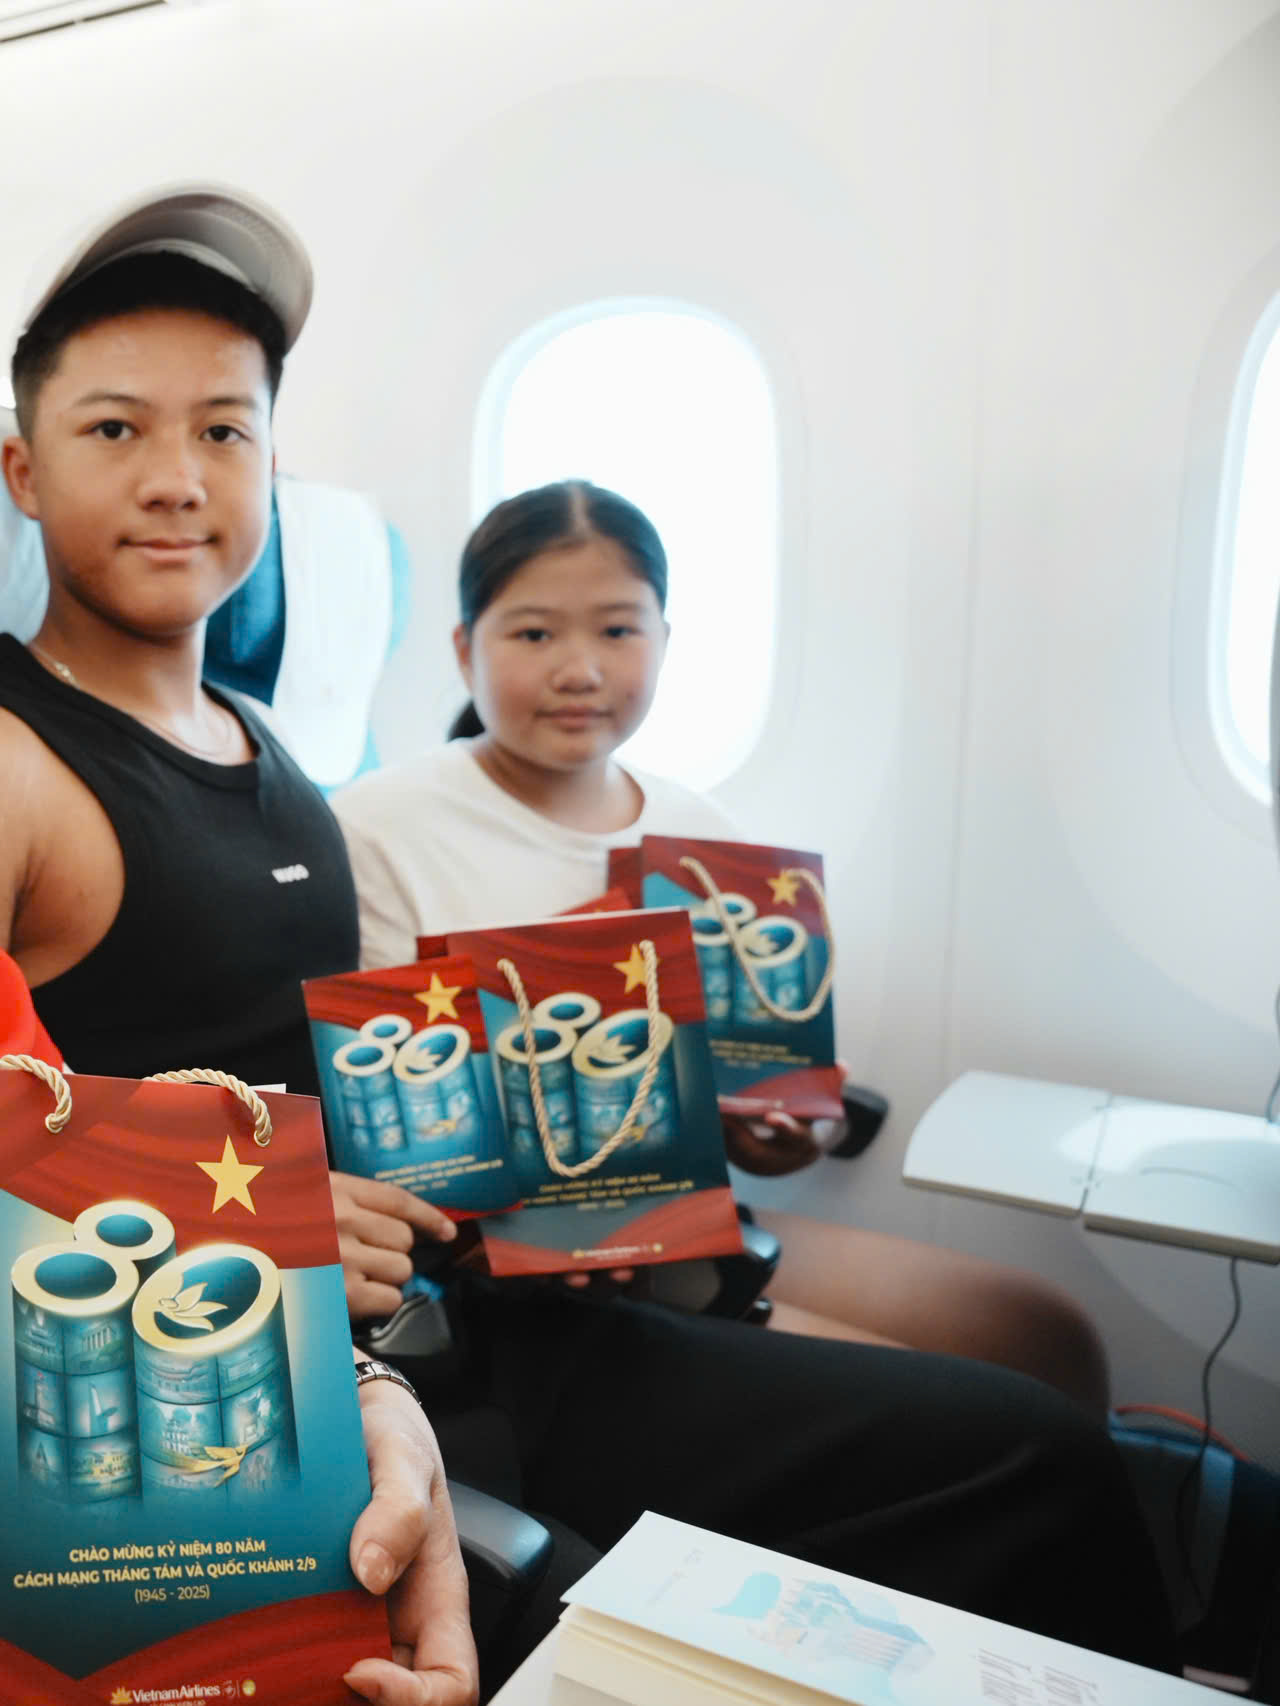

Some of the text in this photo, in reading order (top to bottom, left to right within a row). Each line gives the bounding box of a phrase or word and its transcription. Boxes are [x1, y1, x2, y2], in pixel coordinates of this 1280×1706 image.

[69, 1546, 110, 1563] CHÀO
[112, 1543, 154, 1561] MỪNG
[179, 1539, 212, 1559] NIỆM
[215, 1541, 232, 1556] 80
[235, 1537, 266, 1554] NĂM
[13, 1555, 317, 1588] CÁCH MẠNG THÁNG TÁM VÀ QUỐC KHÁNH 2/9
[134, 1587, 167, 1604] (1945
[177, 1584, 210, 1602] 2025)
